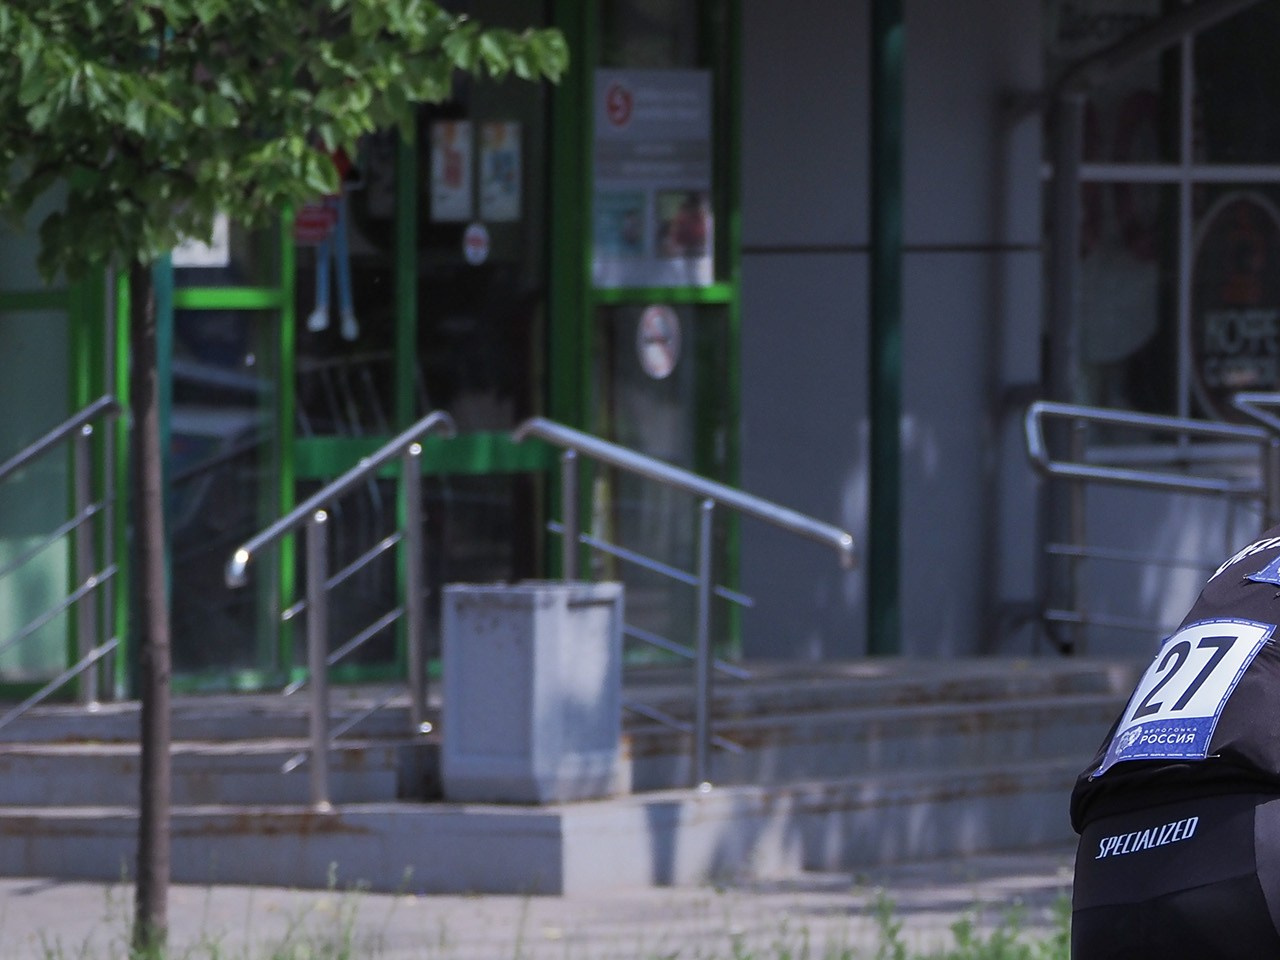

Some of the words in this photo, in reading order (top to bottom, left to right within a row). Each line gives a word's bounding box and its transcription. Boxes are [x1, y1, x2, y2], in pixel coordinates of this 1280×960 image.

[1131, 636, 1239, 722] 27
[1139, 733, 1196, 745] РОССИЯ
[1095, 816, 1199, 860] SPECIALIZED
